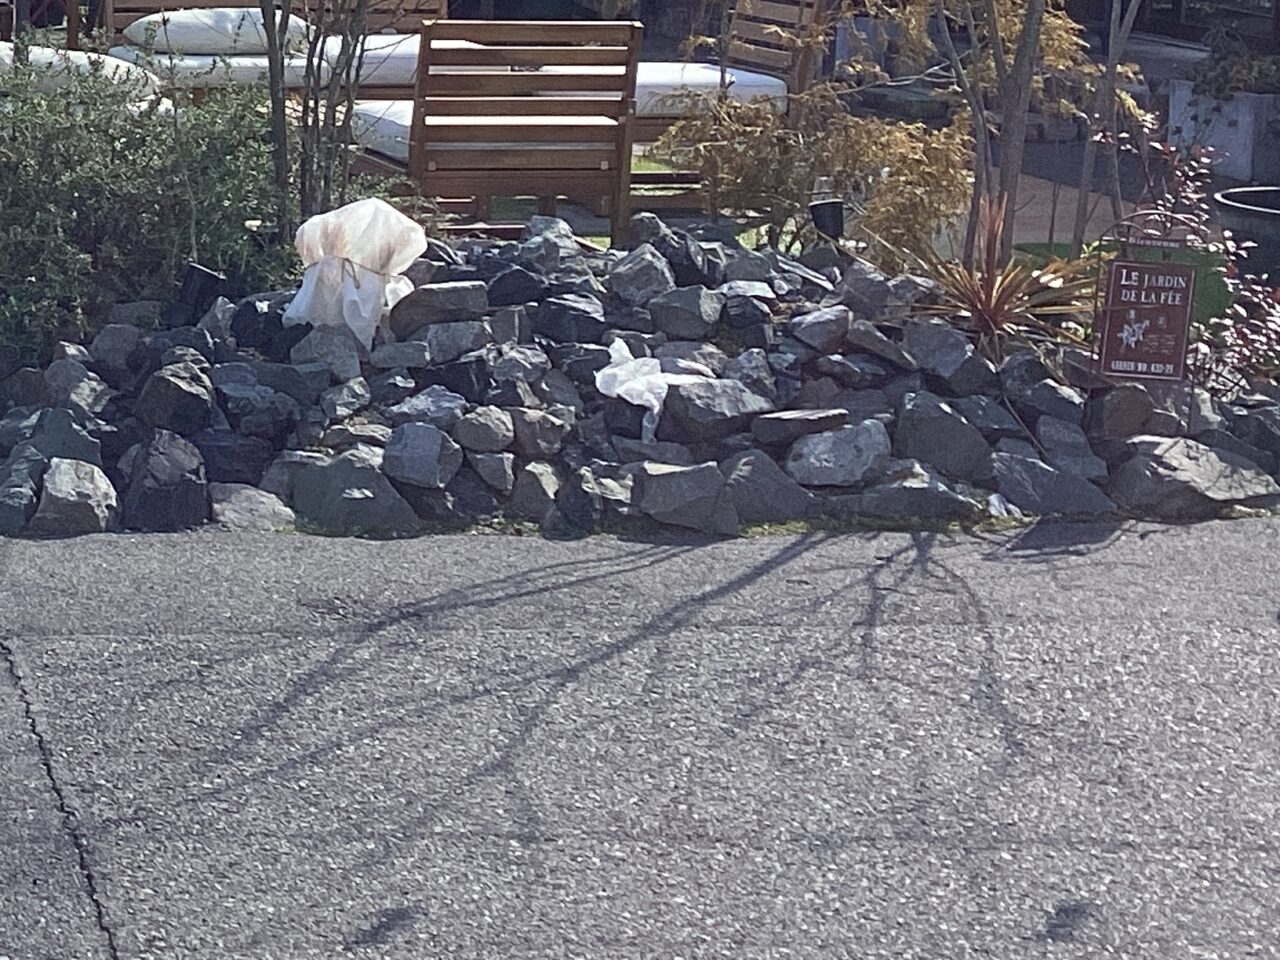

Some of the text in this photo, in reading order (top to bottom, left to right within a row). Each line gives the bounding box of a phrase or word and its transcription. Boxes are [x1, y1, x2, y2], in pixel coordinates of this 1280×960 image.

[1120, 269, 1187, 289] LE JARDIN
[1121, 289, 1138, 302] DE
[1141, 290, 1157, 303] LA
